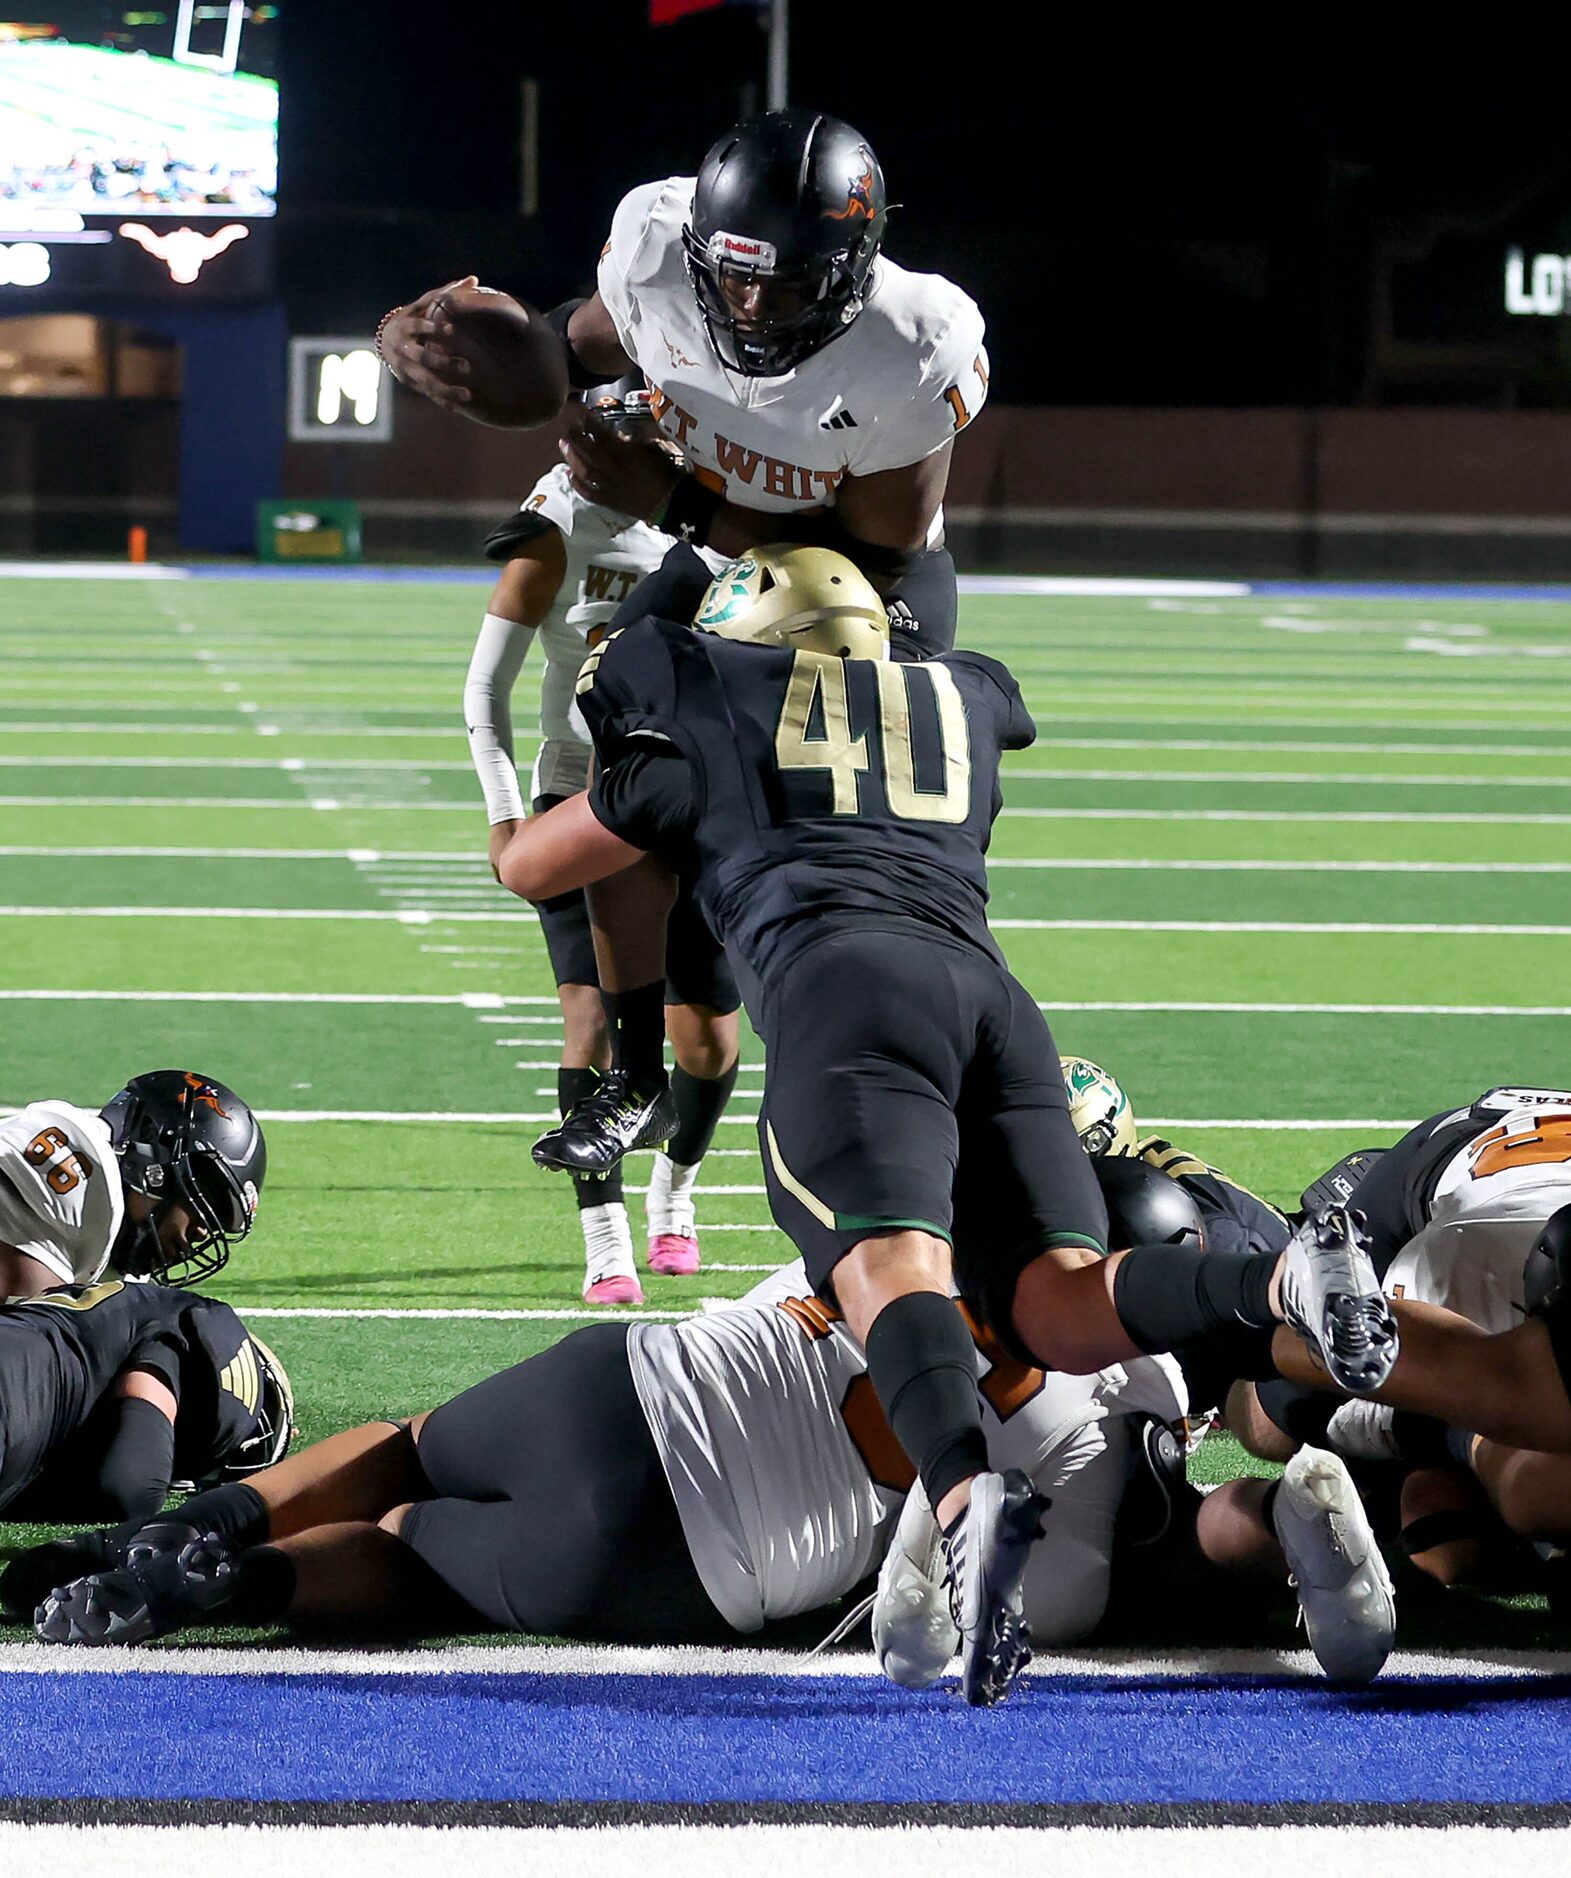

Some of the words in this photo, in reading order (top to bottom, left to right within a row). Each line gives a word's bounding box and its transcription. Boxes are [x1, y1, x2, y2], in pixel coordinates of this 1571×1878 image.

[713, 431, 849, 501] WHIT
[775, 648, 973, 826] 40
[23, 1125, 94, 1196] 66
